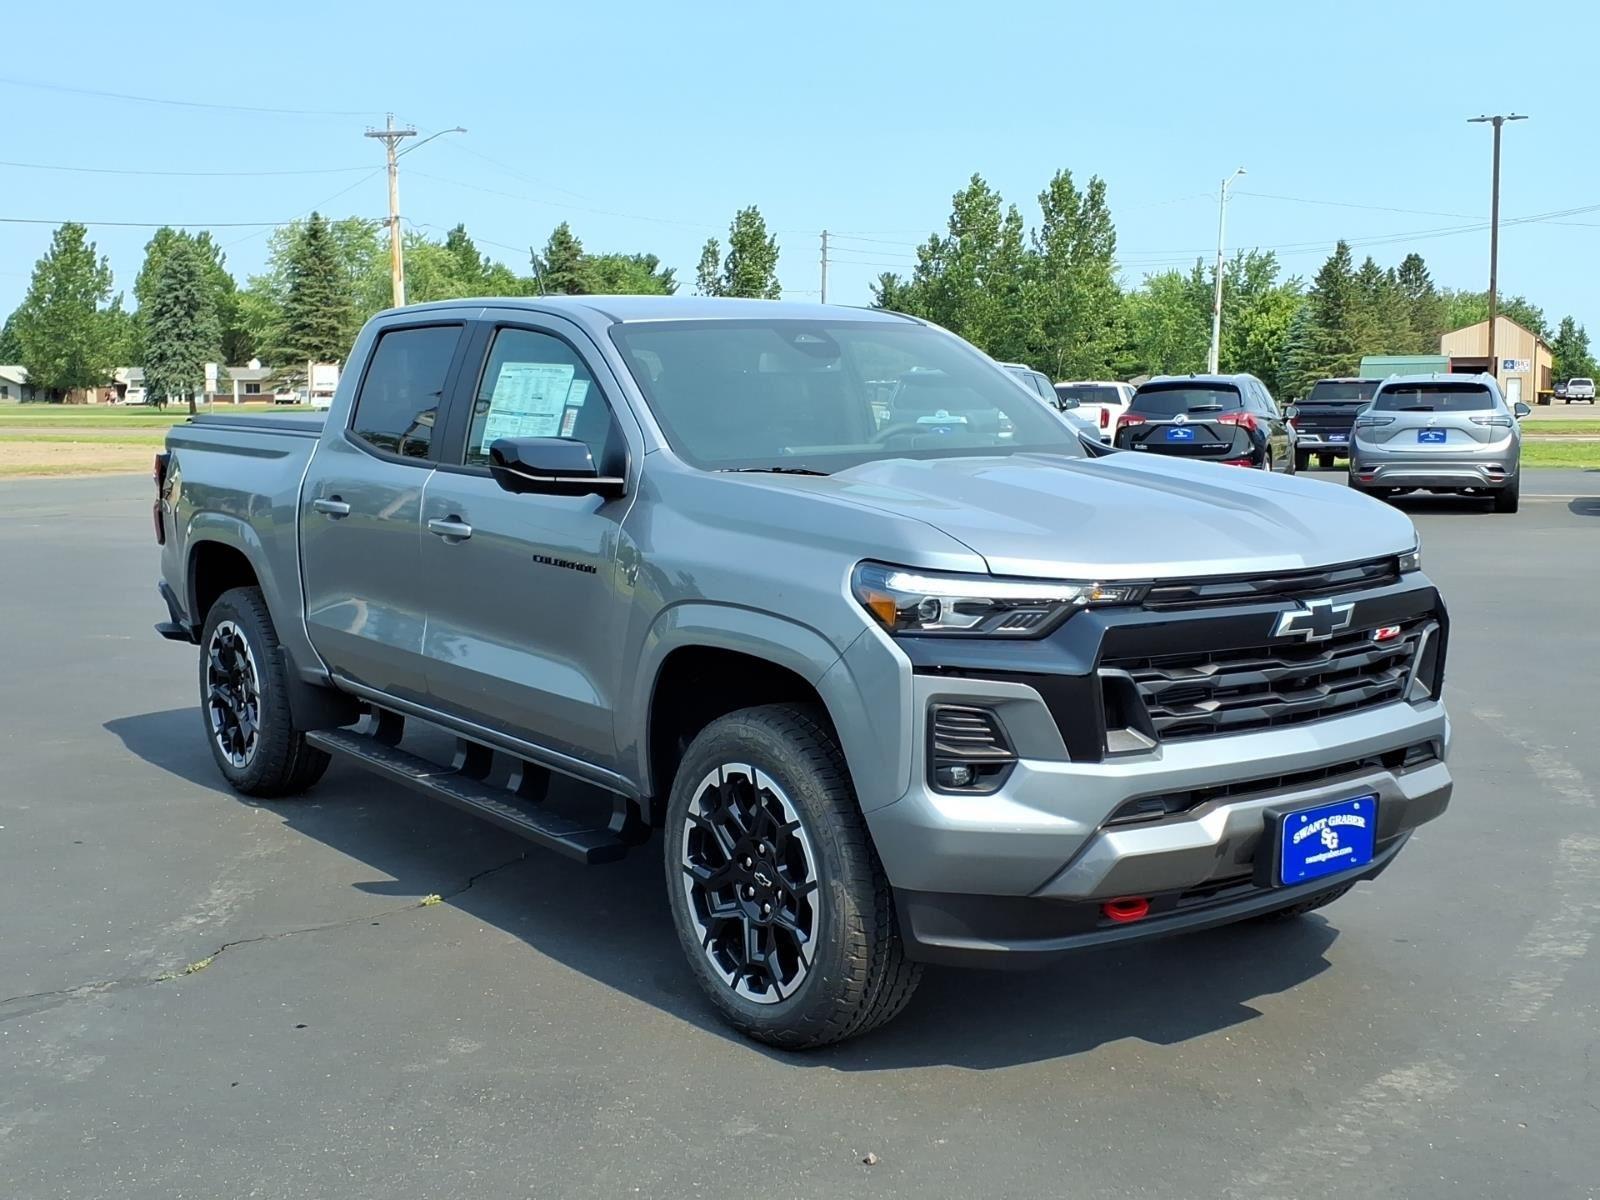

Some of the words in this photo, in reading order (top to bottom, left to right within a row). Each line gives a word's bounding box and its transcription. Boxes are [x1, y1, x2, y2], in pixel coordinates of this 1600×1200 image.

[1293, 818, 1328, 844] SWANT
[1328, 815, 1365, 828] GRABER
[1321, 828, 1339, 849] SG
